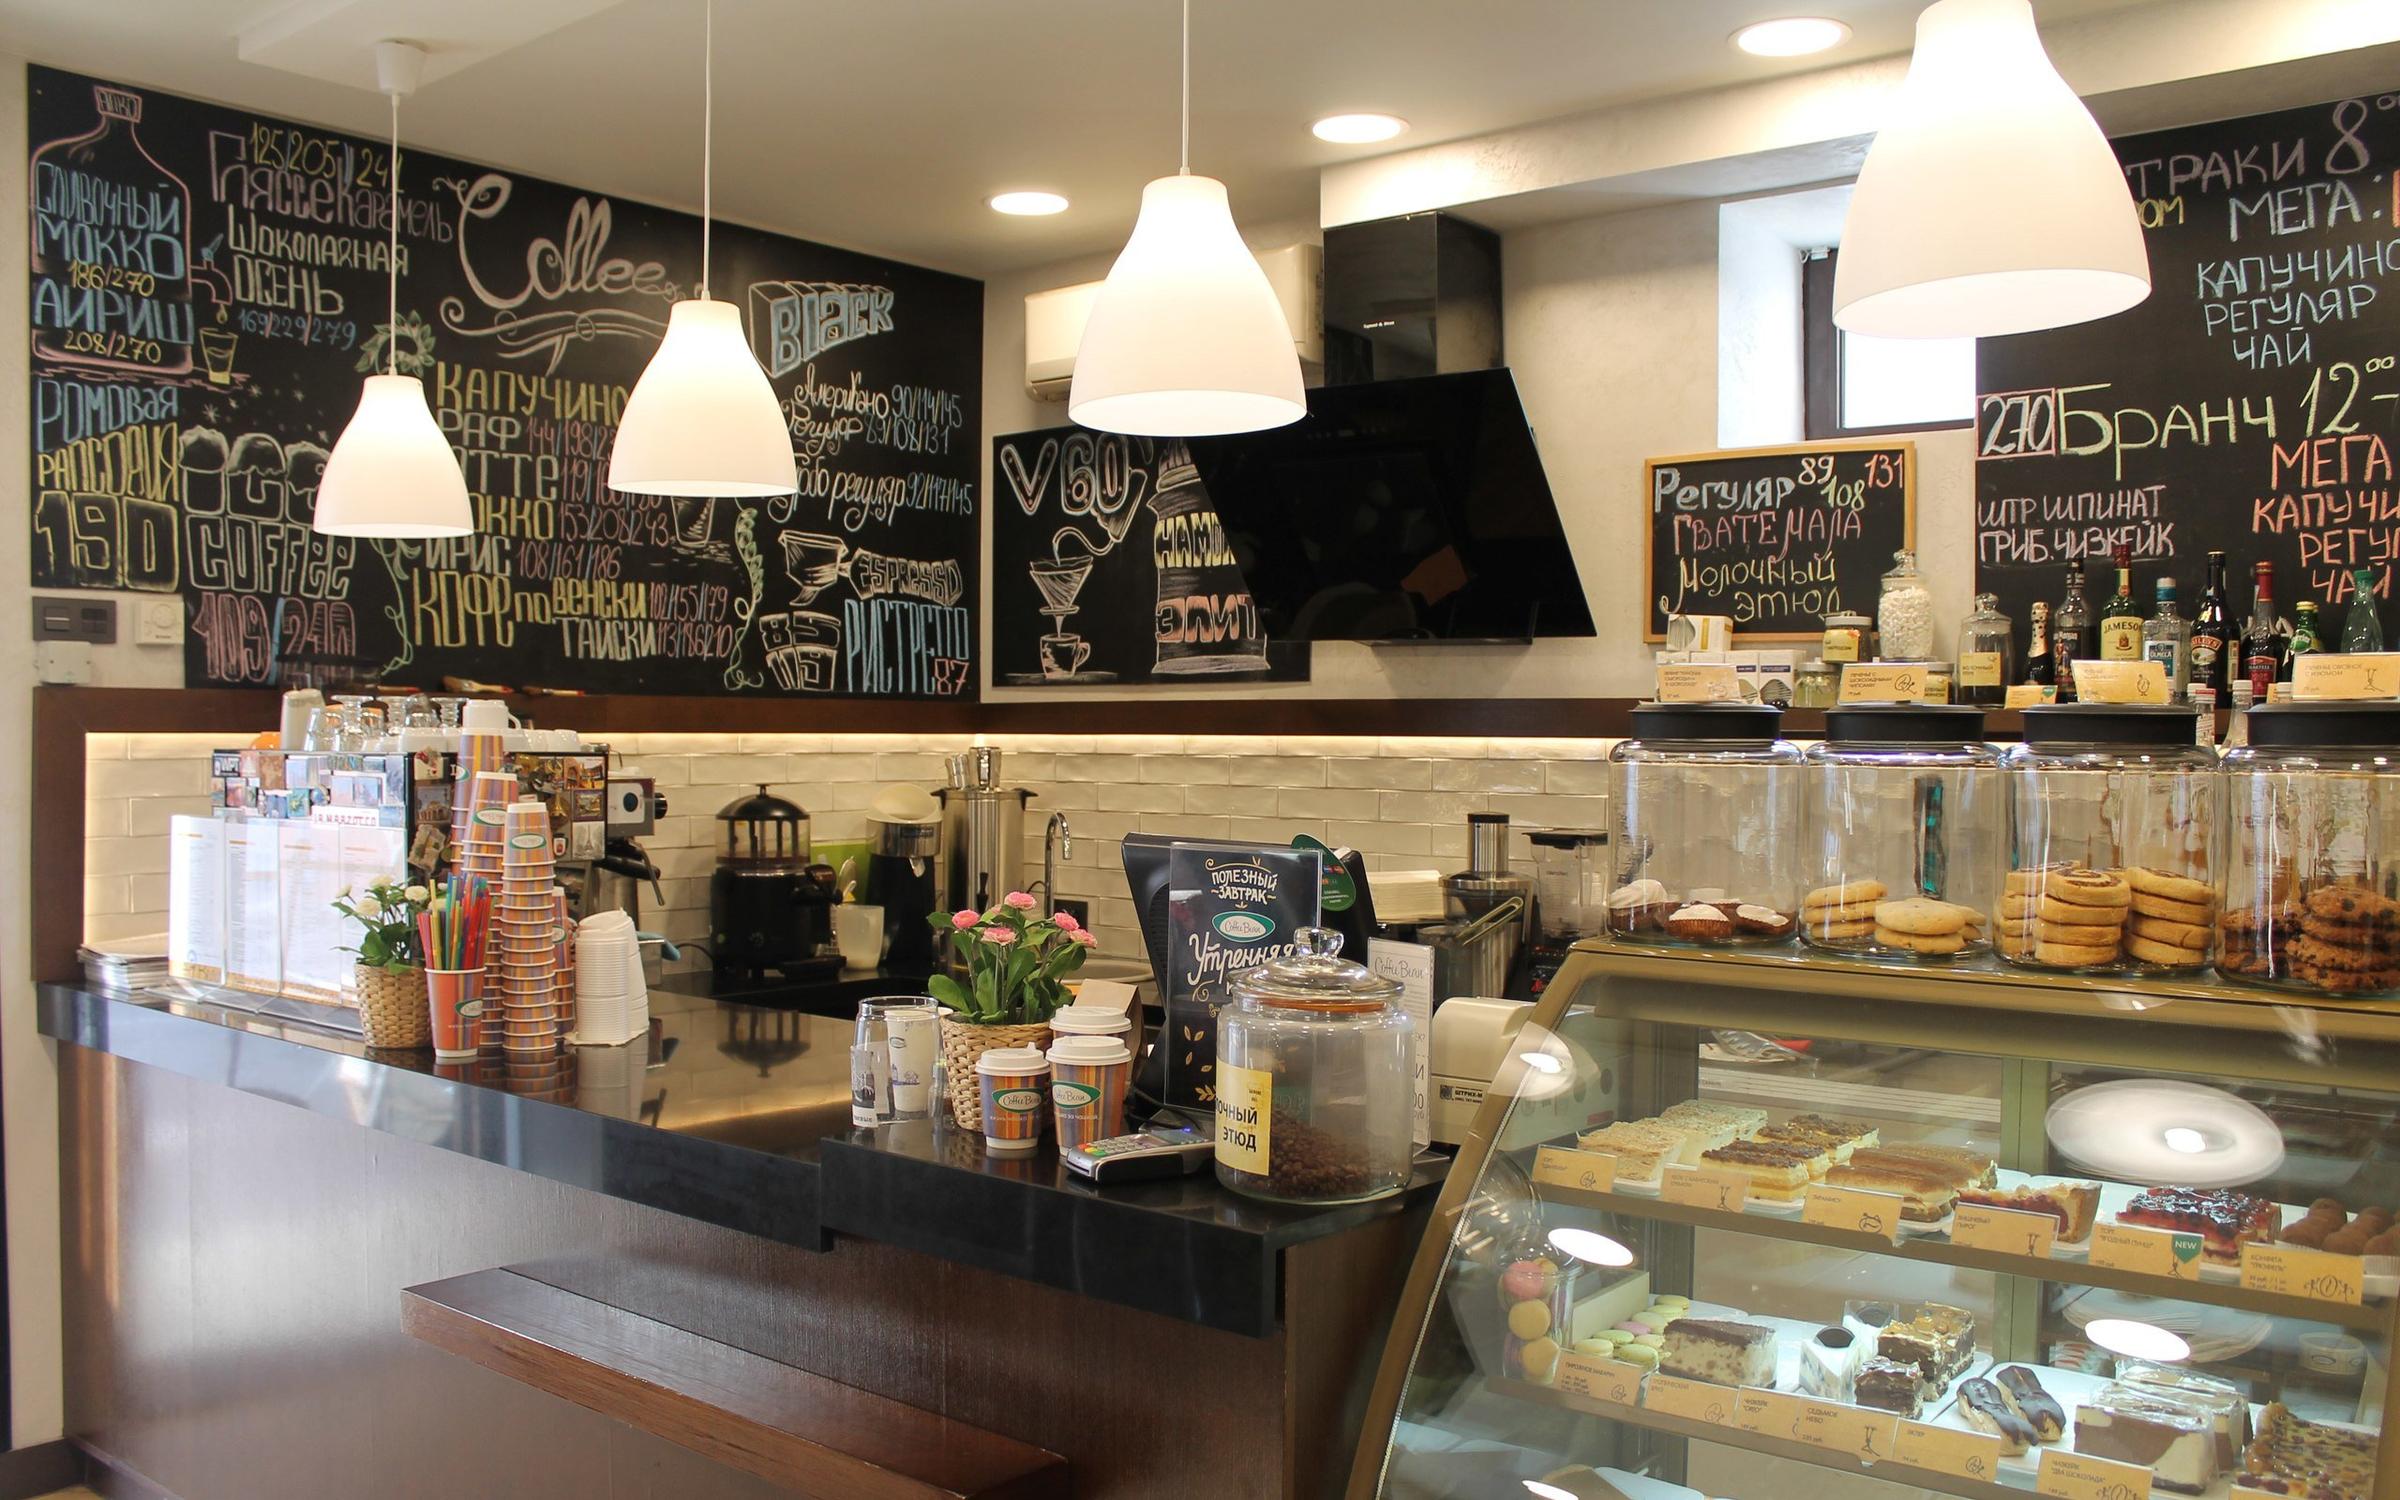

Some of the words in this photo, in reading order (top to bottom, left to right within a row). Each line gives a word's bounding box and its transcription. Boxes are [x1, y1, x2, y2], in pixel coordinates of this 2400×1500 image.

[2125, 138, 2305, 199] ТРАКИ
[37, 213, 185, 280] МОККО
[232, 254, 344, 316] ОСЕНЬ
[2203, 284, 2377, 336] РЕГУЛЯР
[2232, 326, 2312, 370] ЧАЙ
[436, 361, 629, 427] КАПУЧИНО
[436, 408, 521, 452] РАФ
[1981, 394, 2055, 457] 270
[1000, 431, 1130, 516] V60
[1654, 467, 1796, 513] Регуляр
[1797, 455, 1836, 486] 89
[1820, 475, 1866, 512] 108
[2270, 433, 2394, 491] МЕГА
[2041, 485, 2167, 523] ШПИНАТ
[1673, 507, 1863, 565] ГВАТЕМАЛА
[845, 599, 970, 694] РИСТРЕТТО
[2103, 621, 2143, 634] JAMESO
[1211, 869, 1279, 892] ПОЛЕЗНЫЙ
[1216, 1098, 1258, 1126] ОЧНЫЙ
[1223, 1126, 1257, 1153] ЭТЮД
[2175, 1240, 2198, 1250] NEW
